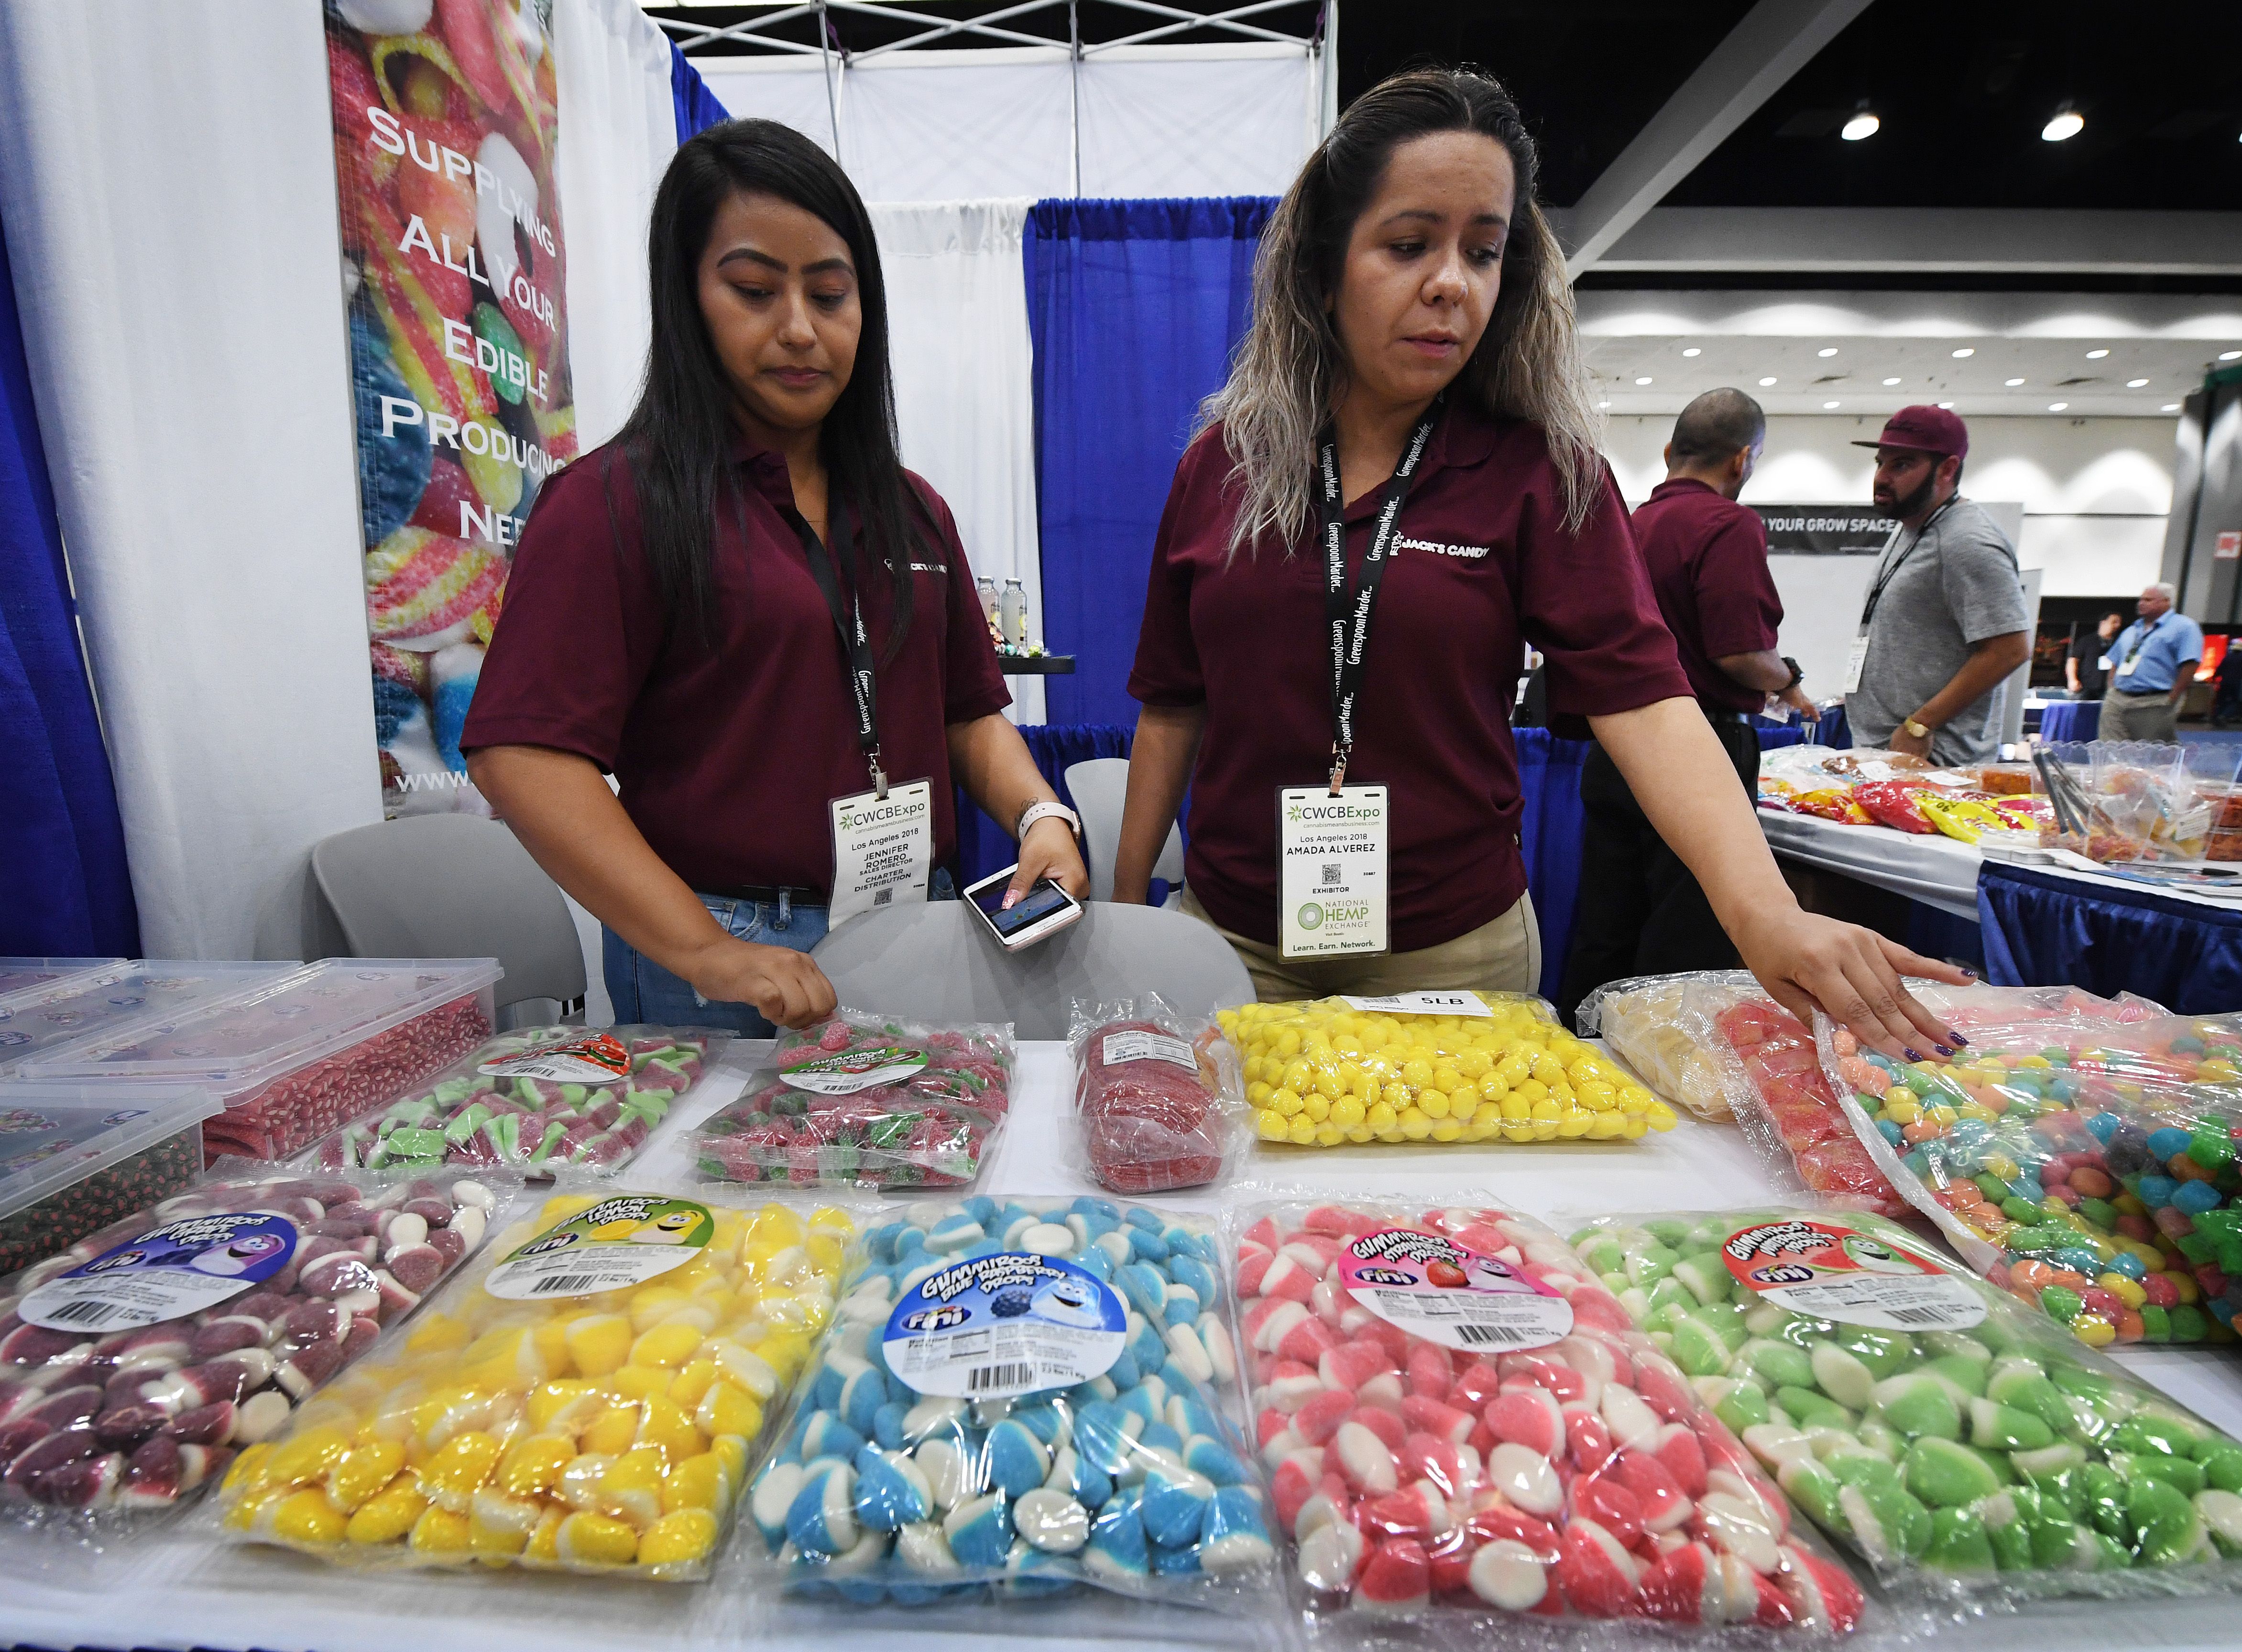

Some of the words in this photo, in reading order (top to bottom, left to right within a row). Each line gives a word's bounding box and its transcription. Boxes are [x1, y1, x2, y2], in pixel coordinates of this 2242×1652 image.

[367, 106, 555, 258] SUPPLYING
[398, 213, 489, 287] ALL
[495, 254, 556, 332] YOUR
[442, 316, 548, 402] EDIBLE
[1769, 518, 1805, 532] YOUR
[1806, 518, 1848, 532] GROW
[1849, 518, 1894, 533] SPACE
[1402, 538, 1446, 554] JACK'S
[1447, 544, 1490, 558] CANDY
[854, 803, 925, 826] CWCBExpo
[1302, 806, 1380, 821] CWCBExpo
[852, 842, 866, 851] Los
[869, 834, 899, 846] Angeles
[902, 828, 919, 838] 2018
[1316, 834, 1347, 843] Angeles
[864, 844, 908, 861] JENNIFER
[1287, 846, 1325, 856] AMADA
[1329, 844, 1376, 854] ALVEREZ
[860, 867, 879, 876] SALES
[881, 858, 913, 870] DIRECTOR
[866, 853, 906, 869] ROMERO
[854, 872, 911, 892] DISTRIBUTION
[866, 869, 903, 883] CHARTER
[1326, 899, 1369, 908] NATIONAL
[1325, 907, 1368, 922] HEMP
[1325, 921, 1369, 930] EXCHANGE
[1293, 943, 1316, 951] Learn.
[1319, 942, 1338, 950] Earn.
[1341, 940, 1376, 949] Network.
[587, 1205, 646, 1224] LEMON
[600, 1211, 653, 1226] DROPS
[1352, 1231, 1451, 1260] GUMMIROOS
[921, 1254, 1042, 1299] GUMMIROOS
[1361, 1270, 1412, 1284] Fini
[1756, 1265, 1810, 1282] Fini
[940, 1274, 974, 1303] BLUE
[978, 1266, 1067, 1282] RASPBERRY
[980, 1274, 1035, 1294] DROPS
